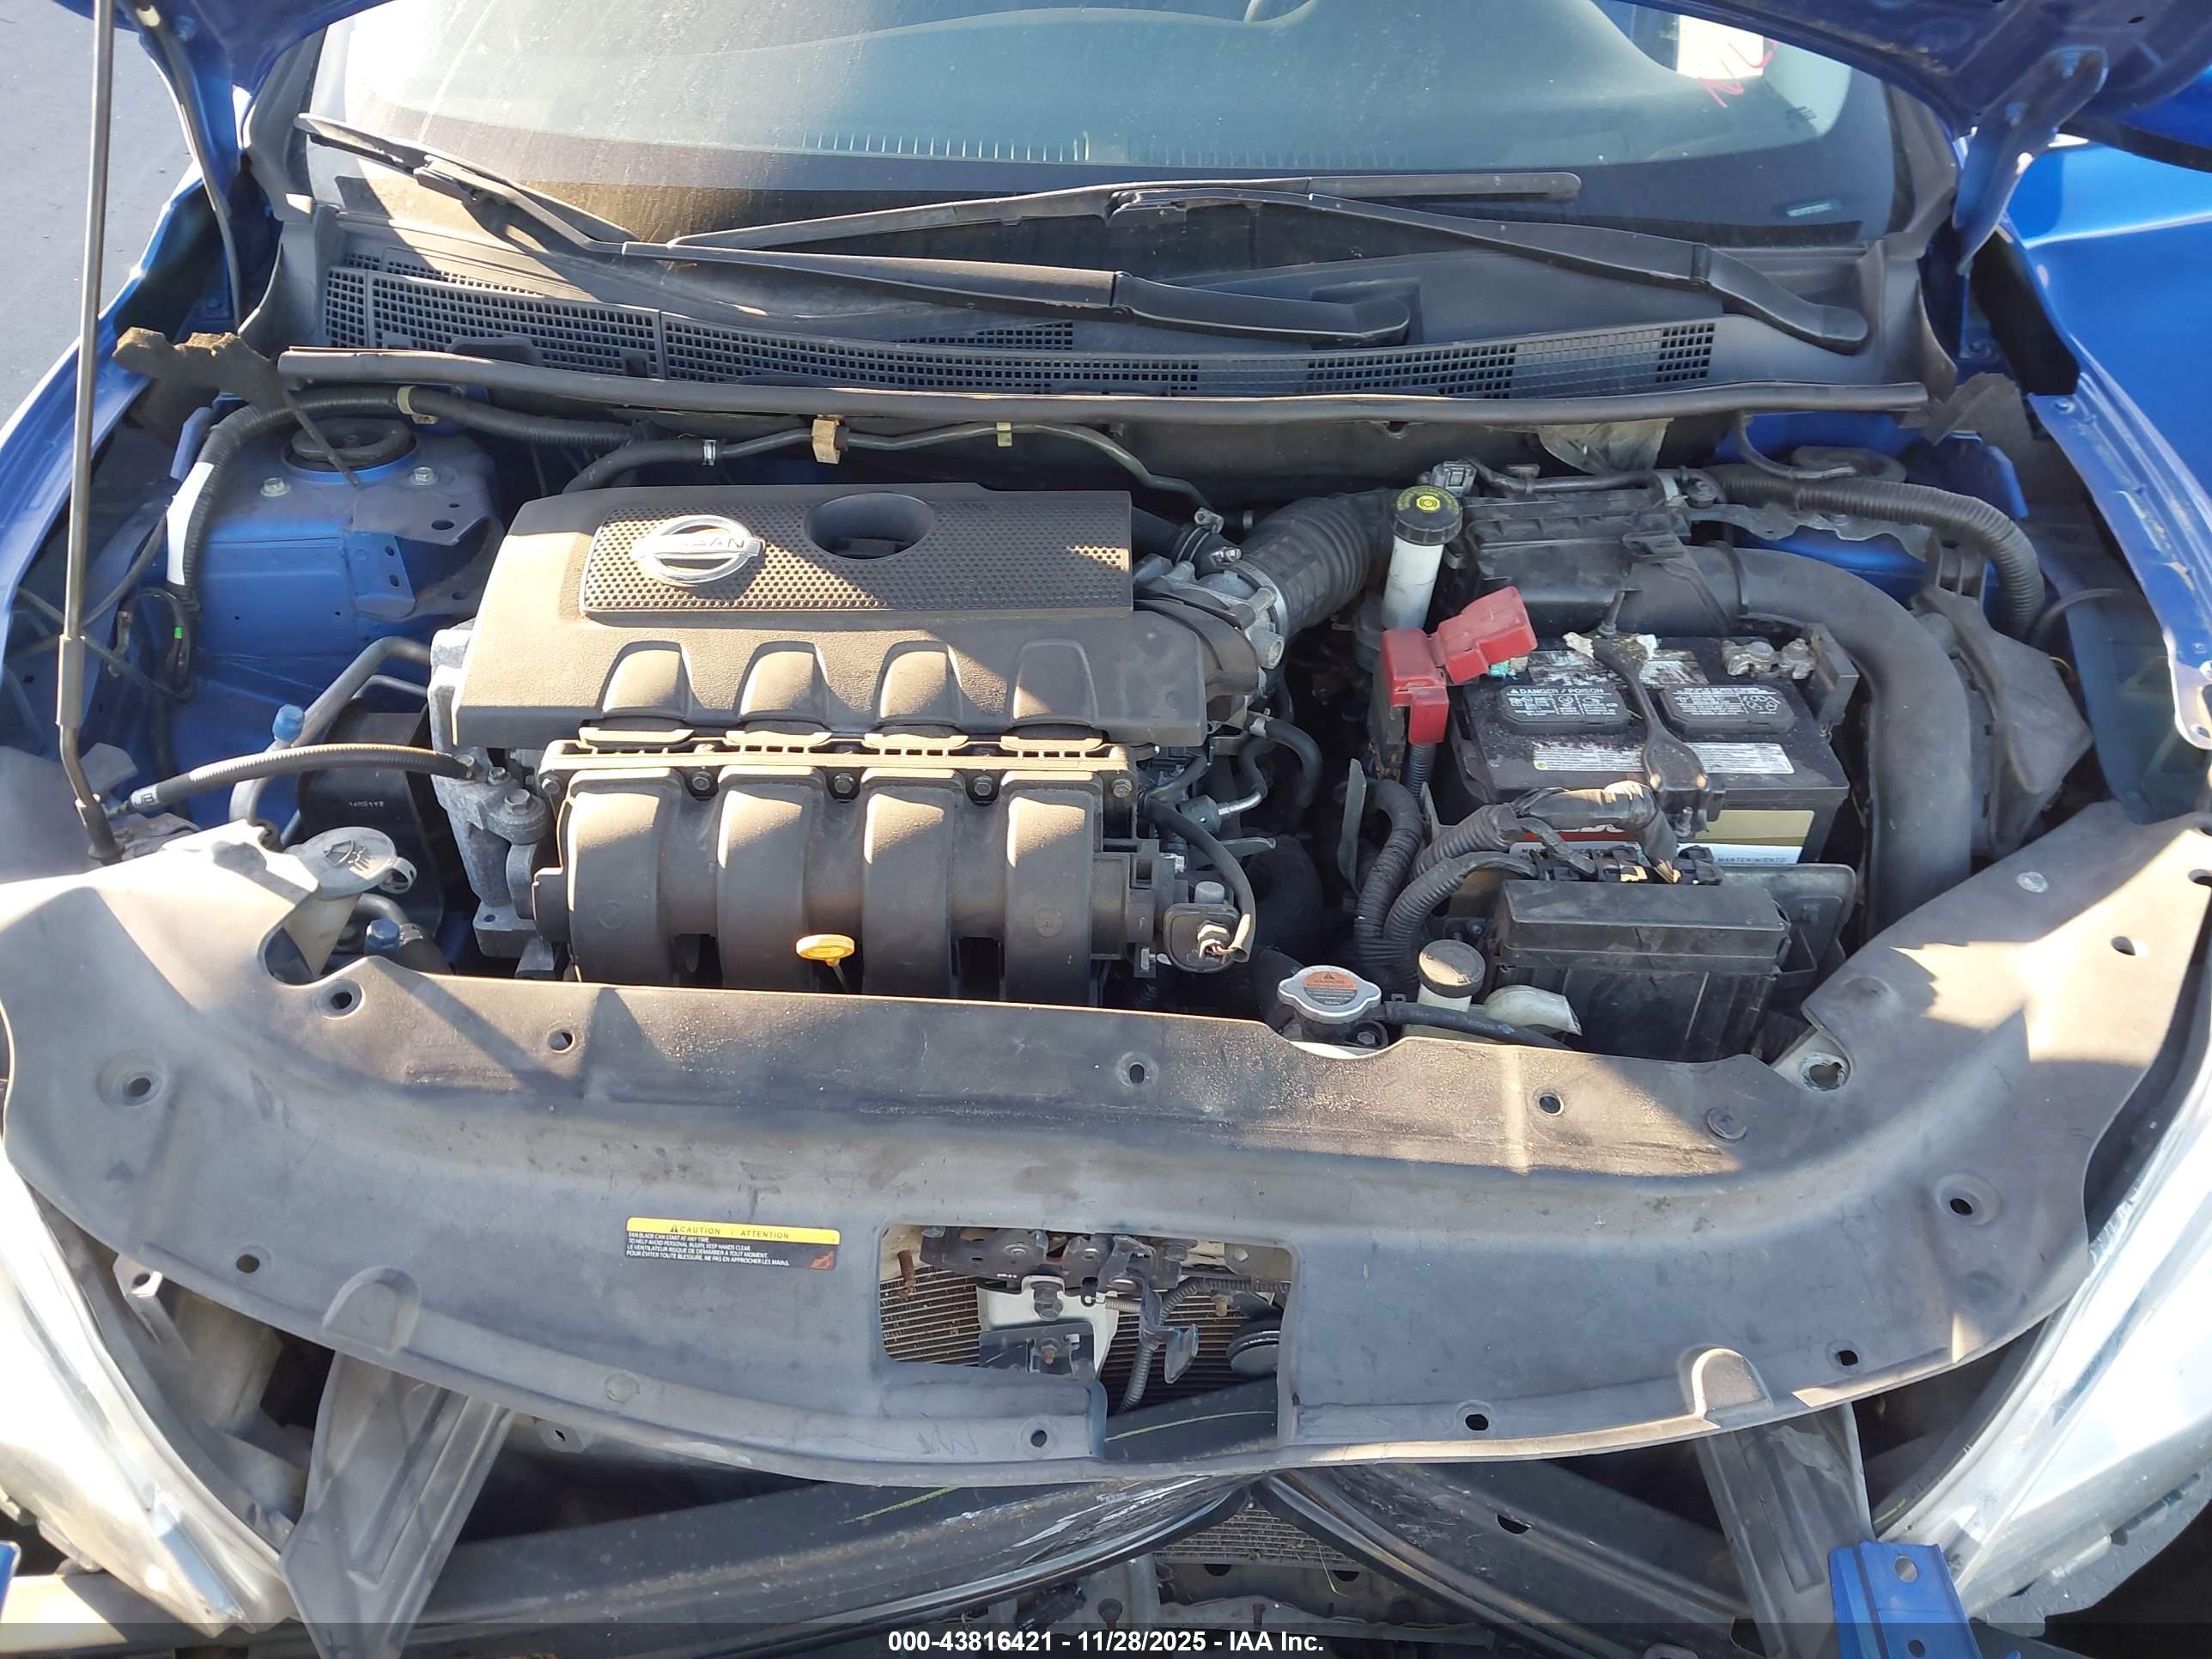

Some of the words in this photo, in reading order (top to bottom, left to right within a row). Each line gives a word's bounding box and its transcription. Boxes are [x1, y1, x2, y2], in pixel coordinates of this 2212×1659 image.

[679, 1226, 721, 1236] CAUTION
[740, 1230, 789, 1239] ATTENTION
[730, 1256, 762, 1265] APPROCHER
